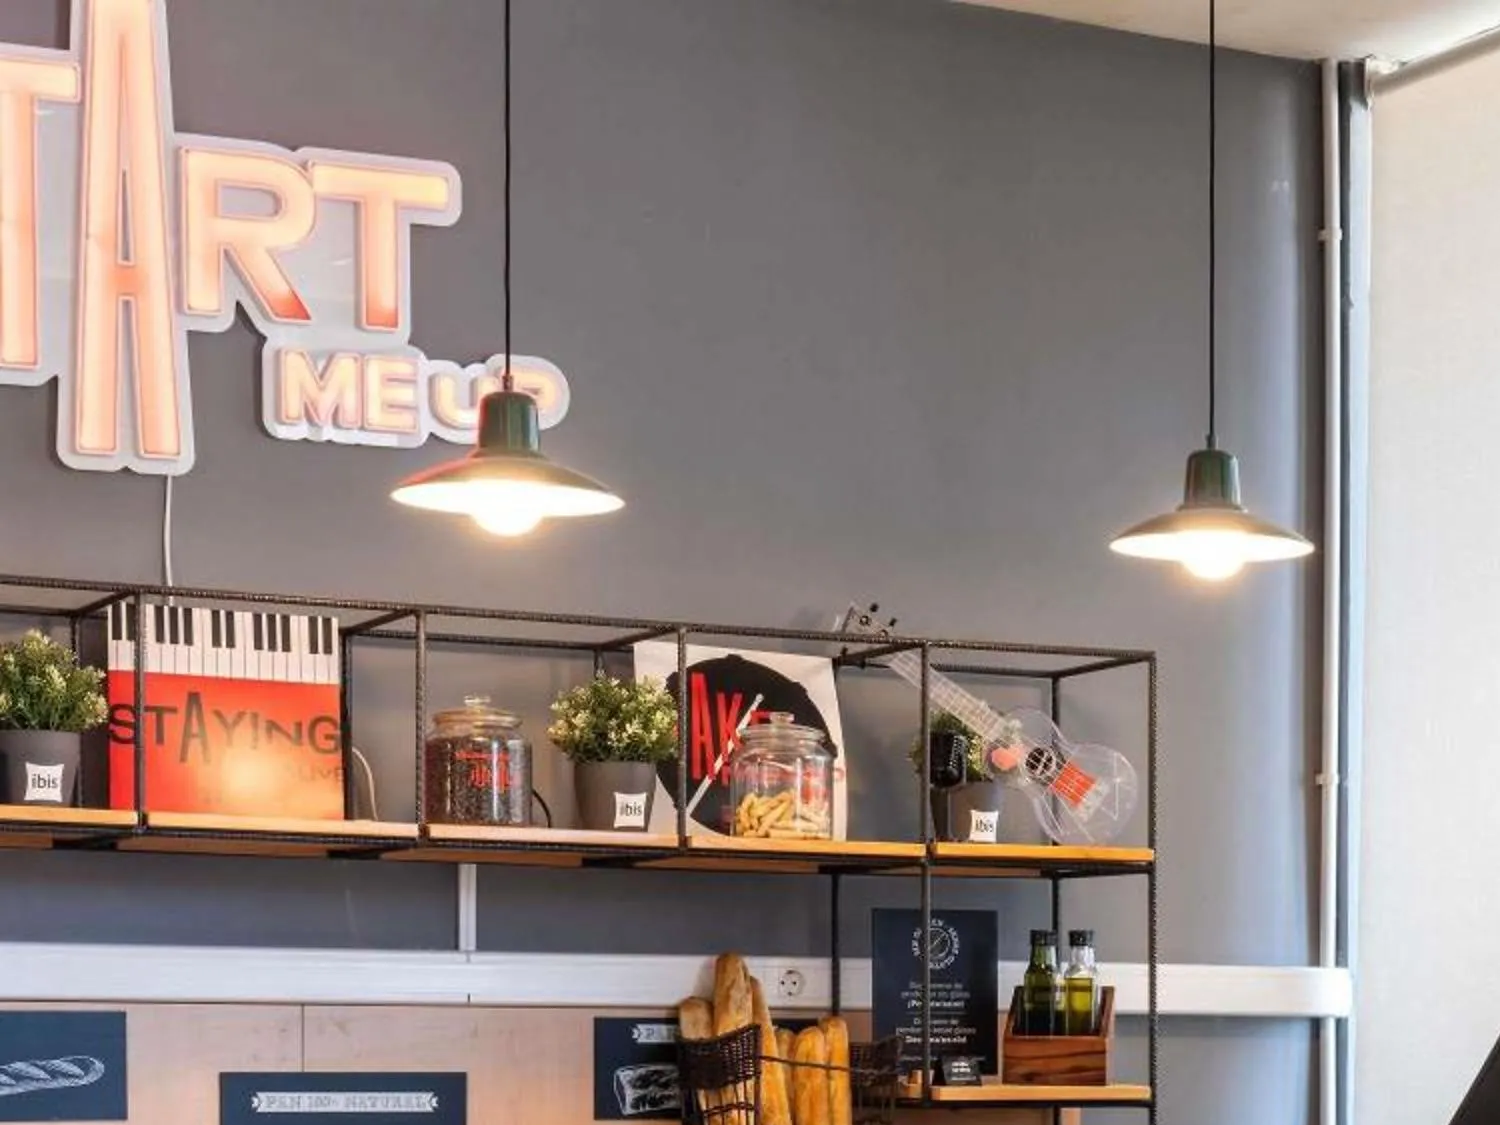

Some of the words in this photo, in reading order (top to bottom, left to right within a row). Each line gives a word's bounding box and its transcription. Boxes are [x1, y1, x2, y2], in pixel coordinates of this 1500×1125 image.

[281, 350, 418, 434] ME
[108, 690, 342, 763] STAYING
[31, 773, 58, 788] ibis
